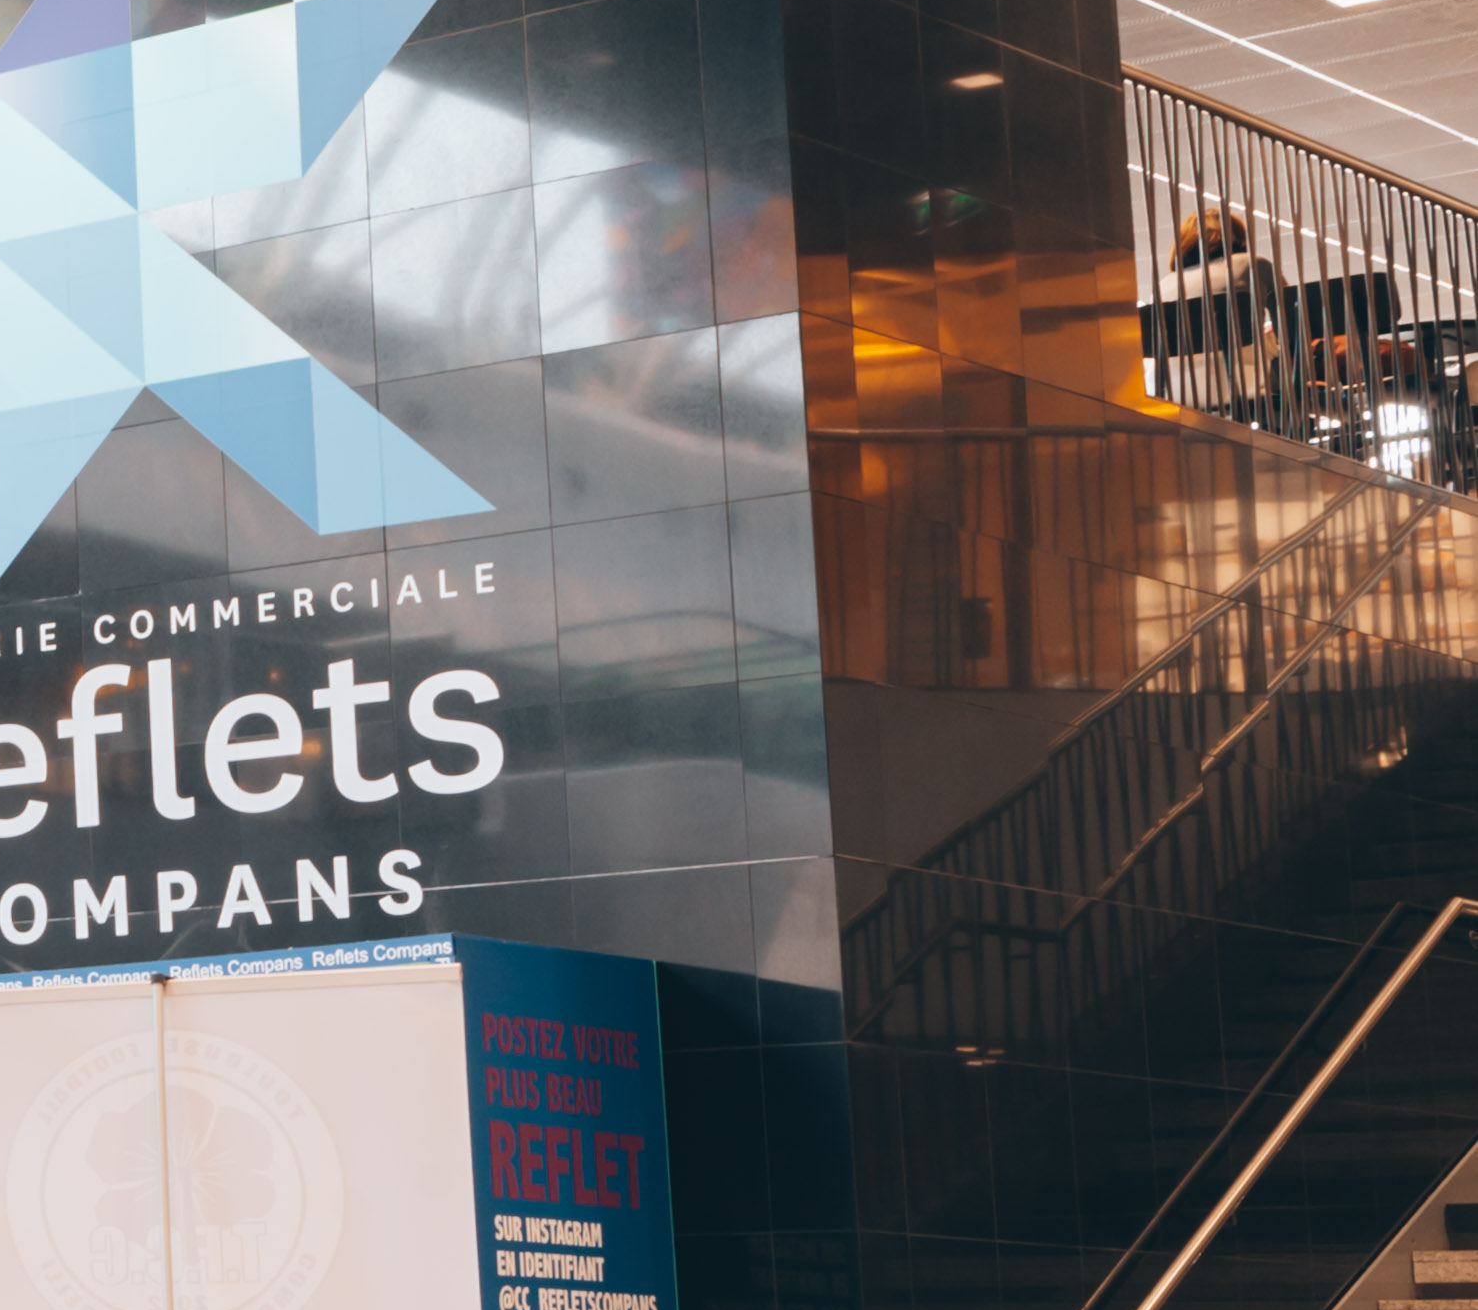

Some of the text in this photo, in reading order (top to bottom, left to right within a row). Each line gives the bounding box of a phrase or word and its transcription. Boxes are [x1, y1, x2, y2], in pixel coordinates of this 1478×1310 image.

[93, 562, 497, 646] COMMERCIALE
[32, 975, 83, 990] Reflets
[170, 962, 223, 980] Reflets
[227, 956, 303, 977] Compans
[312, 949, 368, 968] Reflets
[373, 940, 453, 961] Compans
[482, 1013, 639, 1069] POSTEZ VOTRE
[485, 1066, 602, 1116] PLUS BEAU
[488, 1119, 644, 1209] REFLET
[494, 1215, 602, 1248] SUR INSTAGRAM
[497, 1250, 604, 1281] EN IDENTIFIANT
